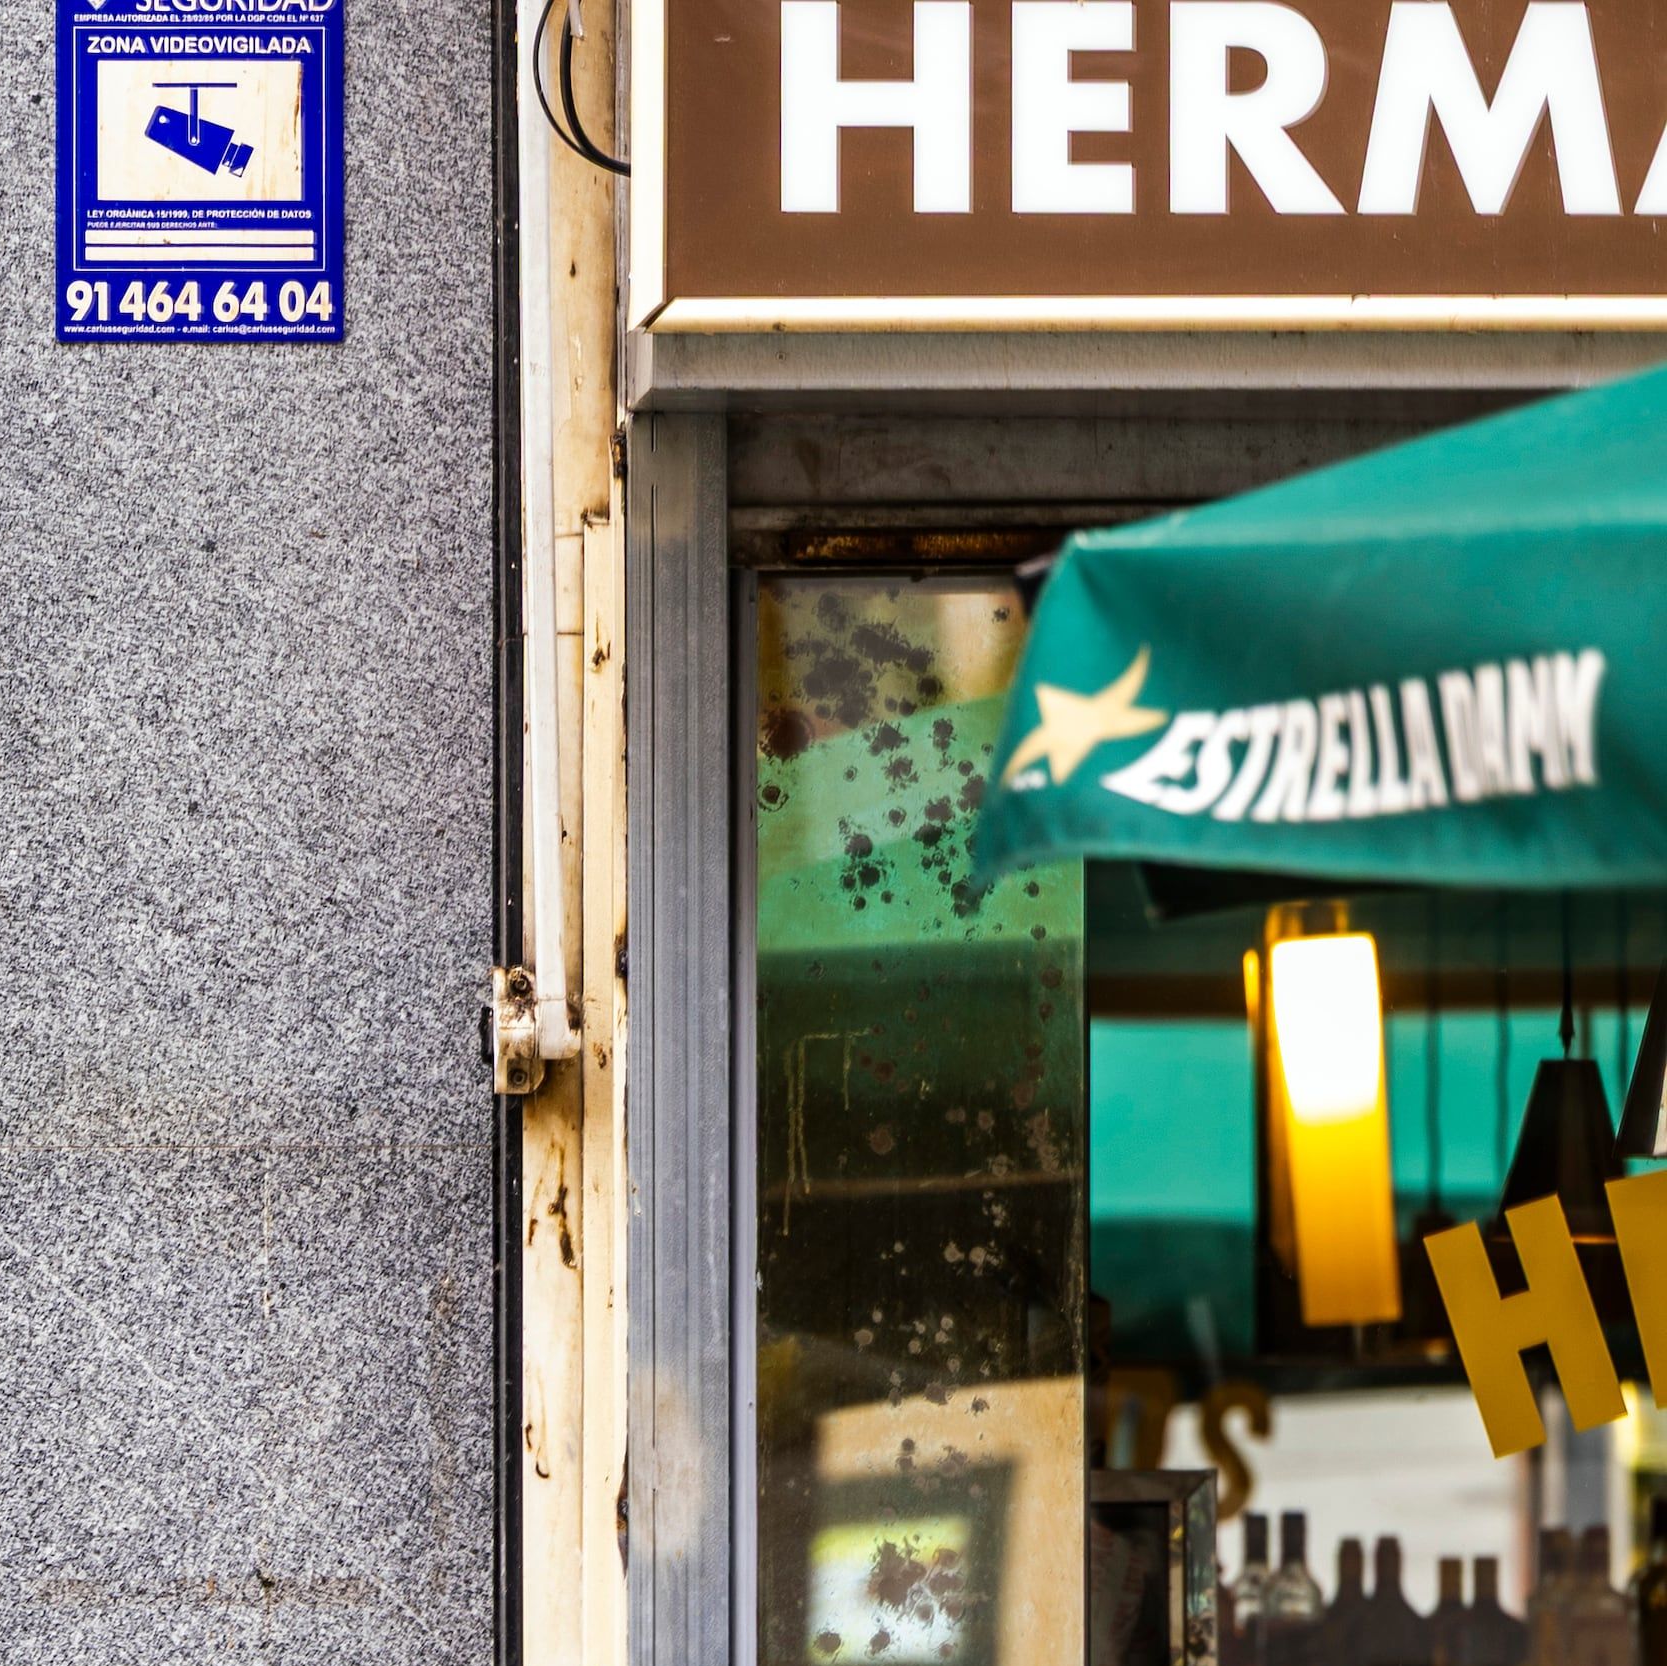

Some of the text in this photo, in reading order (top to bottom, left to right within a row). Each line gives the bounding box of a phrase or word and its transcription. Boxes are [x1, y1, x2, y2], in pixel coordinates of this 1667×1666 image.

[74, 13, 114, 22] EMPRESA
[115, 13, 168, 22] AUTORIZADA
[170, 13, 180, 22] EL
[216, 13, 234, 22] POR
[235, 13, 246, 22] LA
[267, 13, 285, 22] CON
[287, 13, 298, 22] EL
[87, 36, 312, 54] ZONA VIDEOVIGILADA
[780, 0, 1667, 214] HERM
[87, 209, 104, 219] LEY
[106, 207, 155, 219] ORGÁNICA
[192, 209, 204, 219] DE
[206, 207, 266, 219] PROTECCIÓN
[267, 209, 280, 219] DE
[281, 209, 312, 219] DATOS
[66, 280, 333, 323] 91 464 64 04
[1099, 648, 1605, 823] ESTRELLA DAMM
